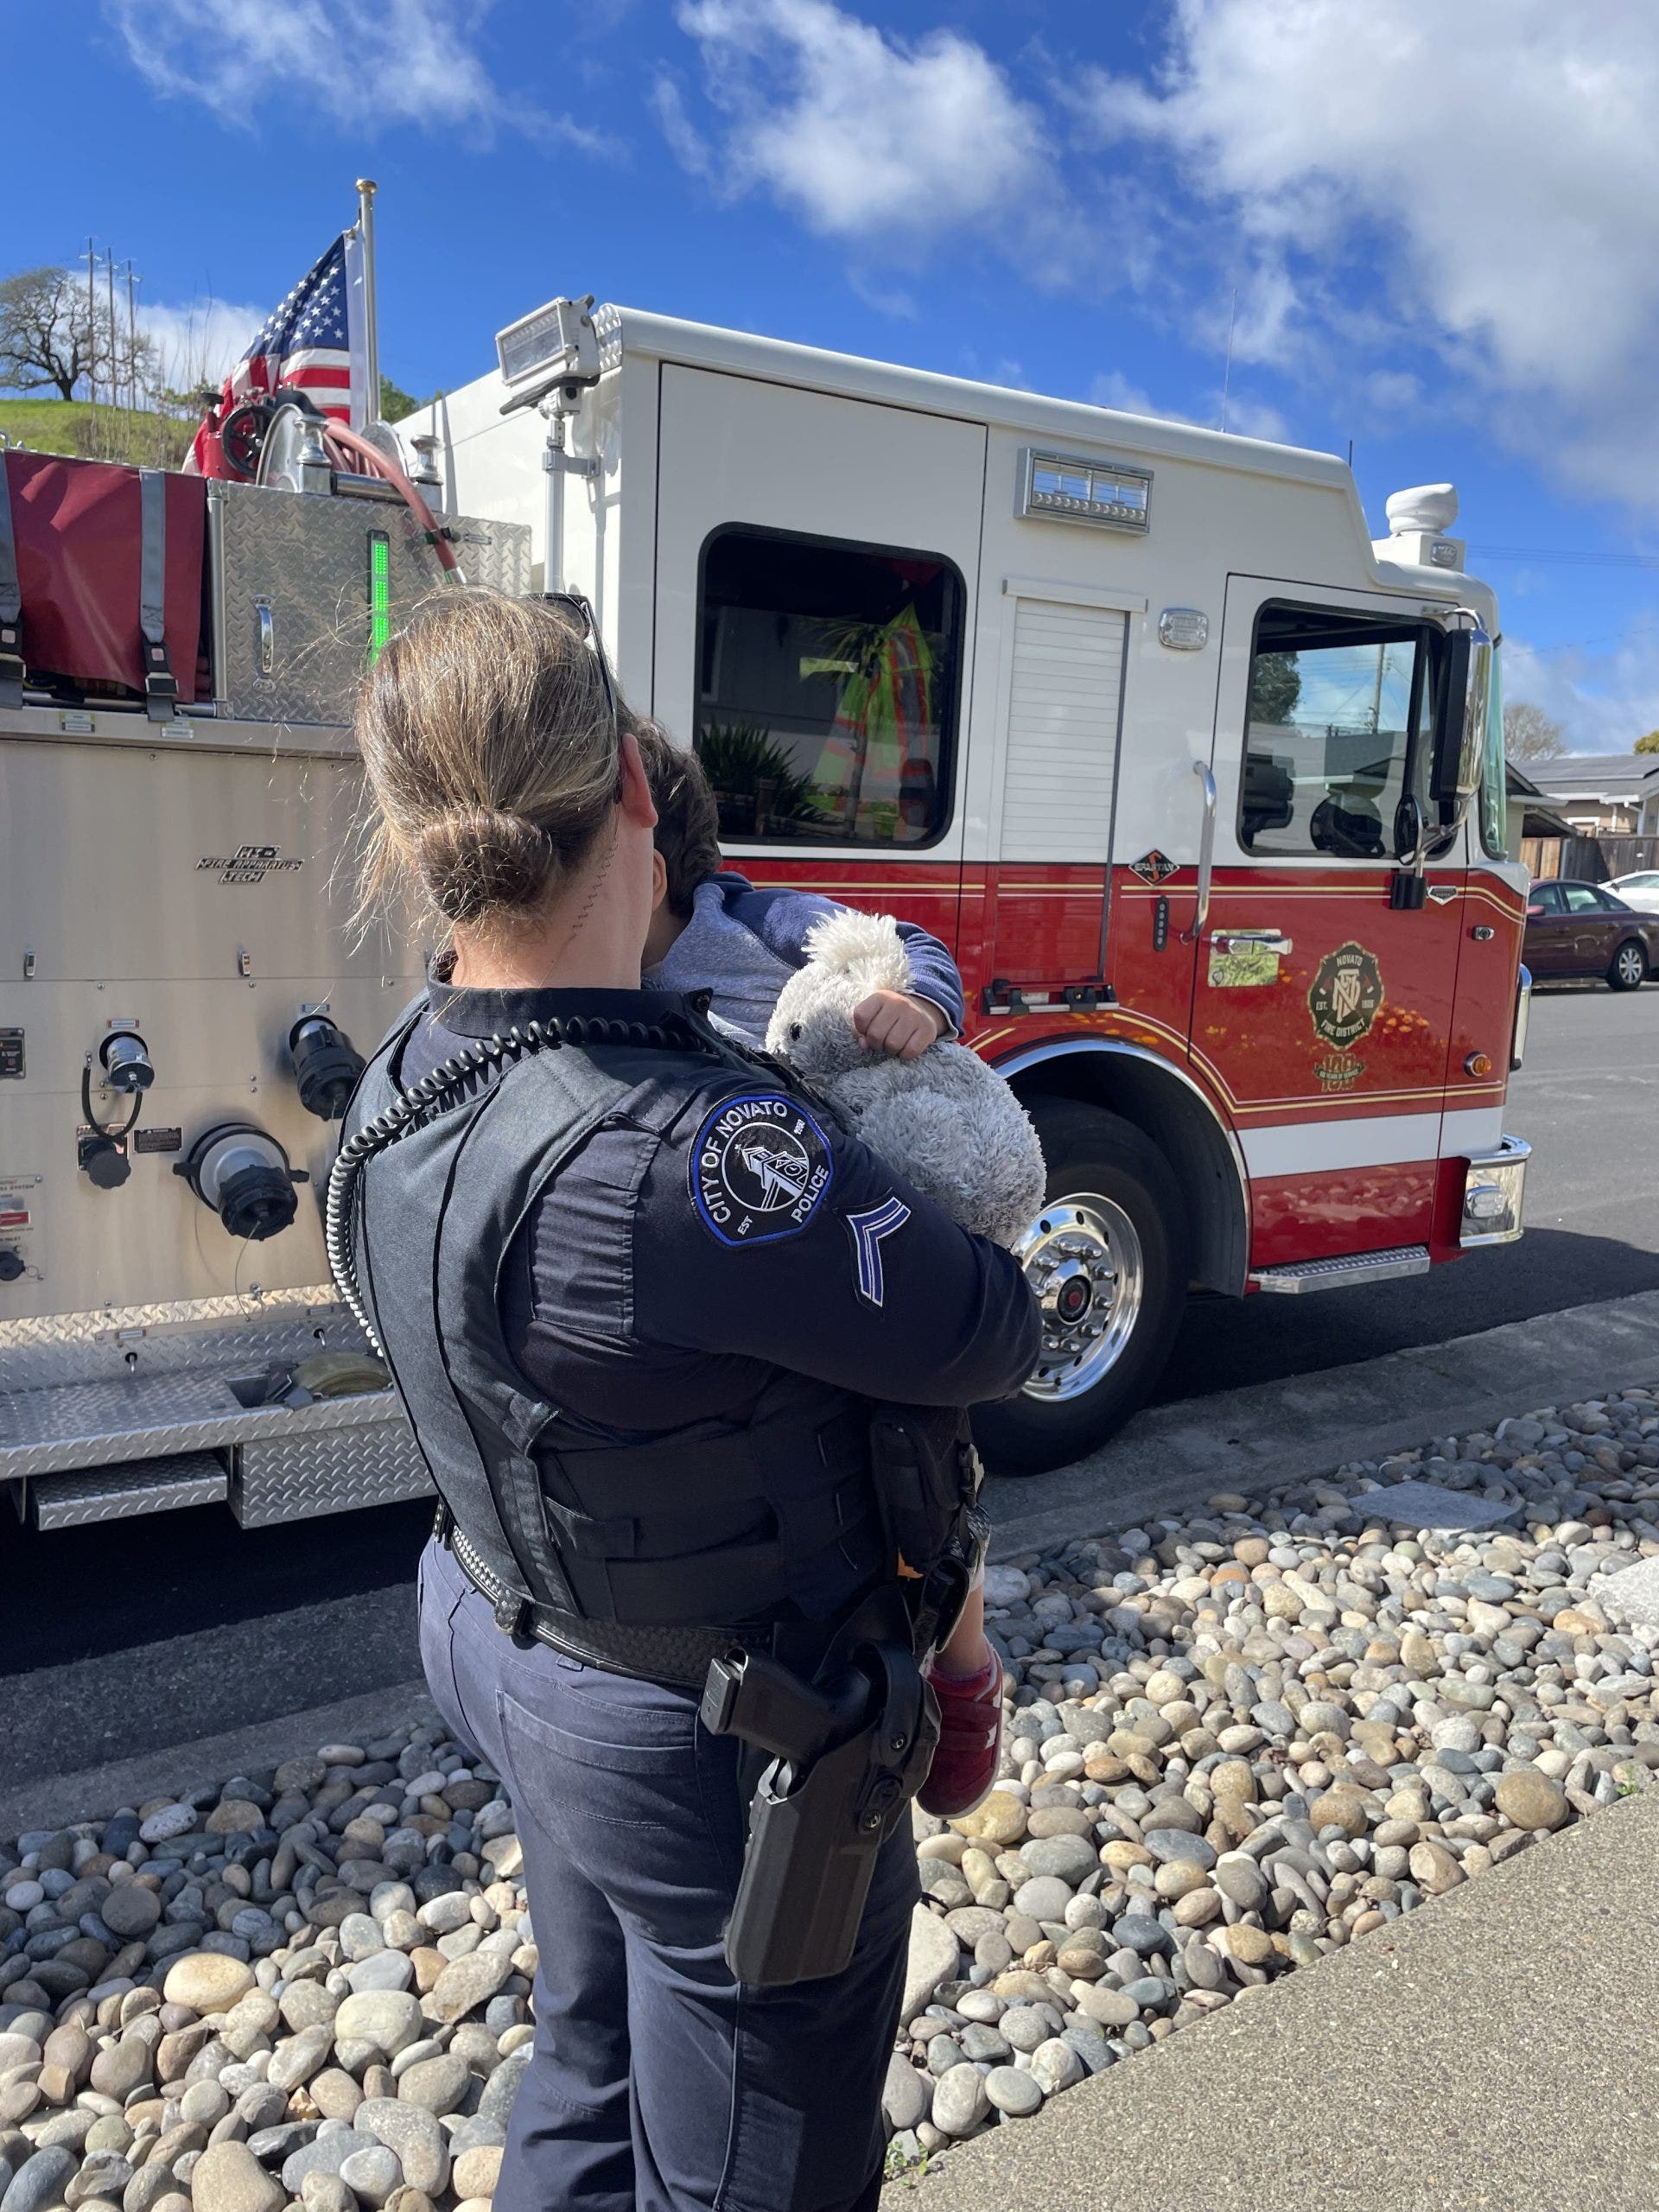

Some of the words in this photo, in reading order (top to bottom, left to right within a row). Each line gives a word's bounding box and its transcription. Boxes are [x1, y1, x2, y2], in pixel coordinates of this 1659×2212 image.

[203, 859, 232, 868] FIRE
[234, 860, 298, 870] APPARATUS
[1135, 862, 1174, 871] SPARTAN
[225, 871, 261, 882] TECH
[1336, 954, 1363, 967] NOVATO
[1320, 1019, 1336, 1036] FIRE
[1336, 1017, 1365, 1038] DISTRICT
[715, 1101, 788, 1139] NOVATO
[701, 1136, 722, 1169] OF
[701, 1175, 731, 1224] CITY
[790, 1164, 830, 1223] POLICE
[737, 1215, 753, 1235] EST
